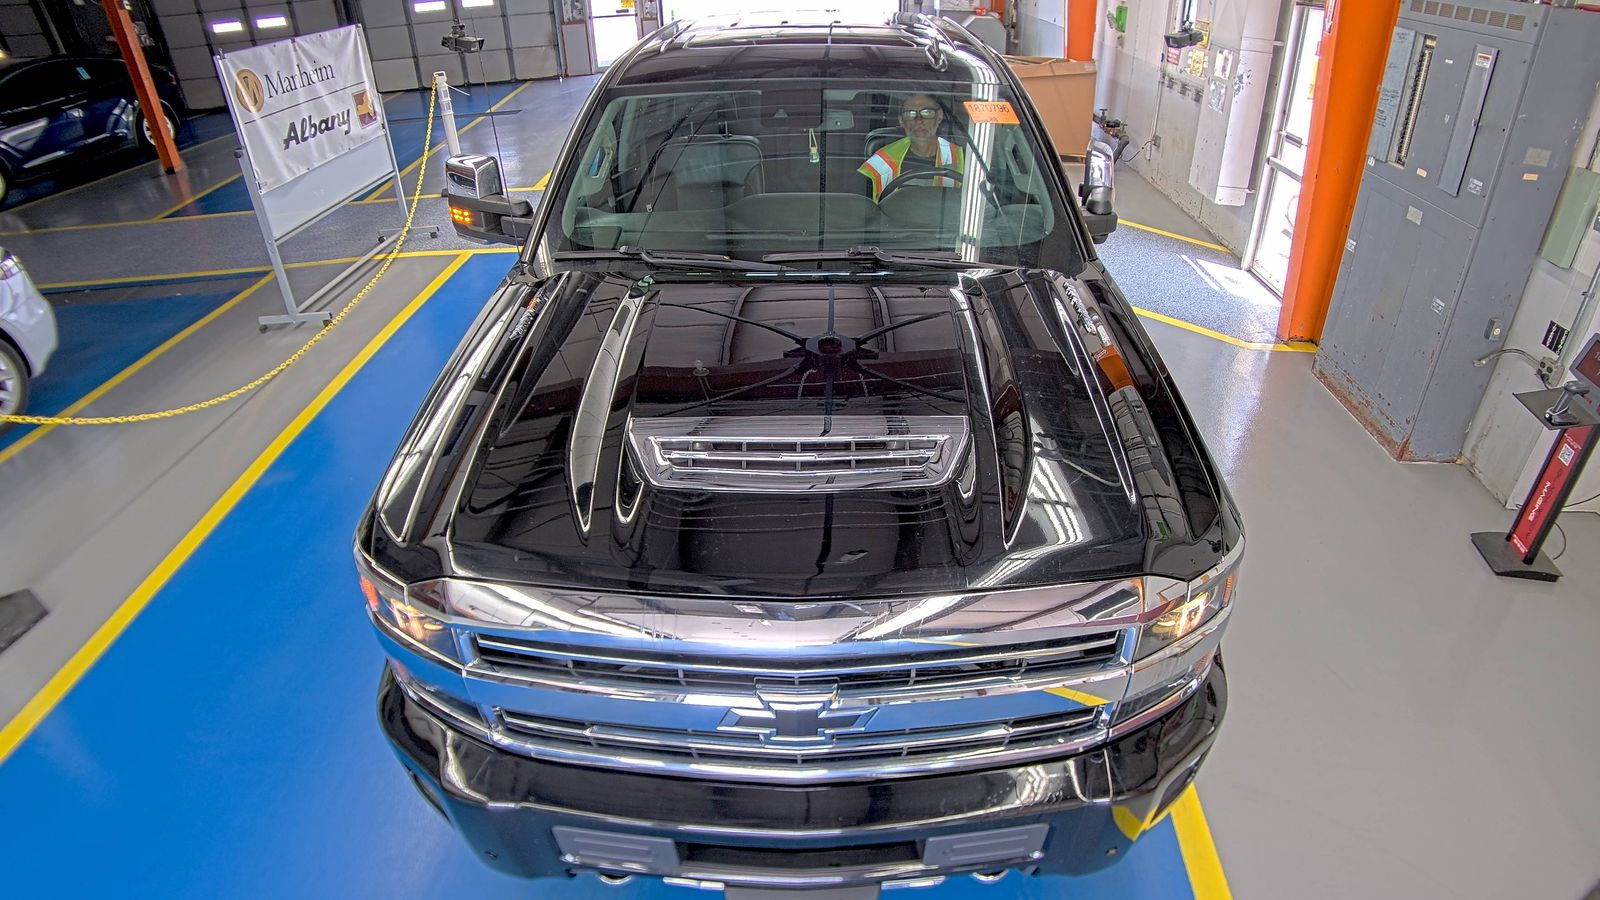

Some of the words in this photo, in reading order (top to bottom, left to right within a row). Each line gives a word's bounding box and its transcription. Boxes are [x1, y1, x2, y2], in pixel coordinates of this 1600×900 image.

[265, 60, 335, 98] Manheim
[968, 104, 1009, 113] 1870796
[283, 108, 351, 150] Albany
